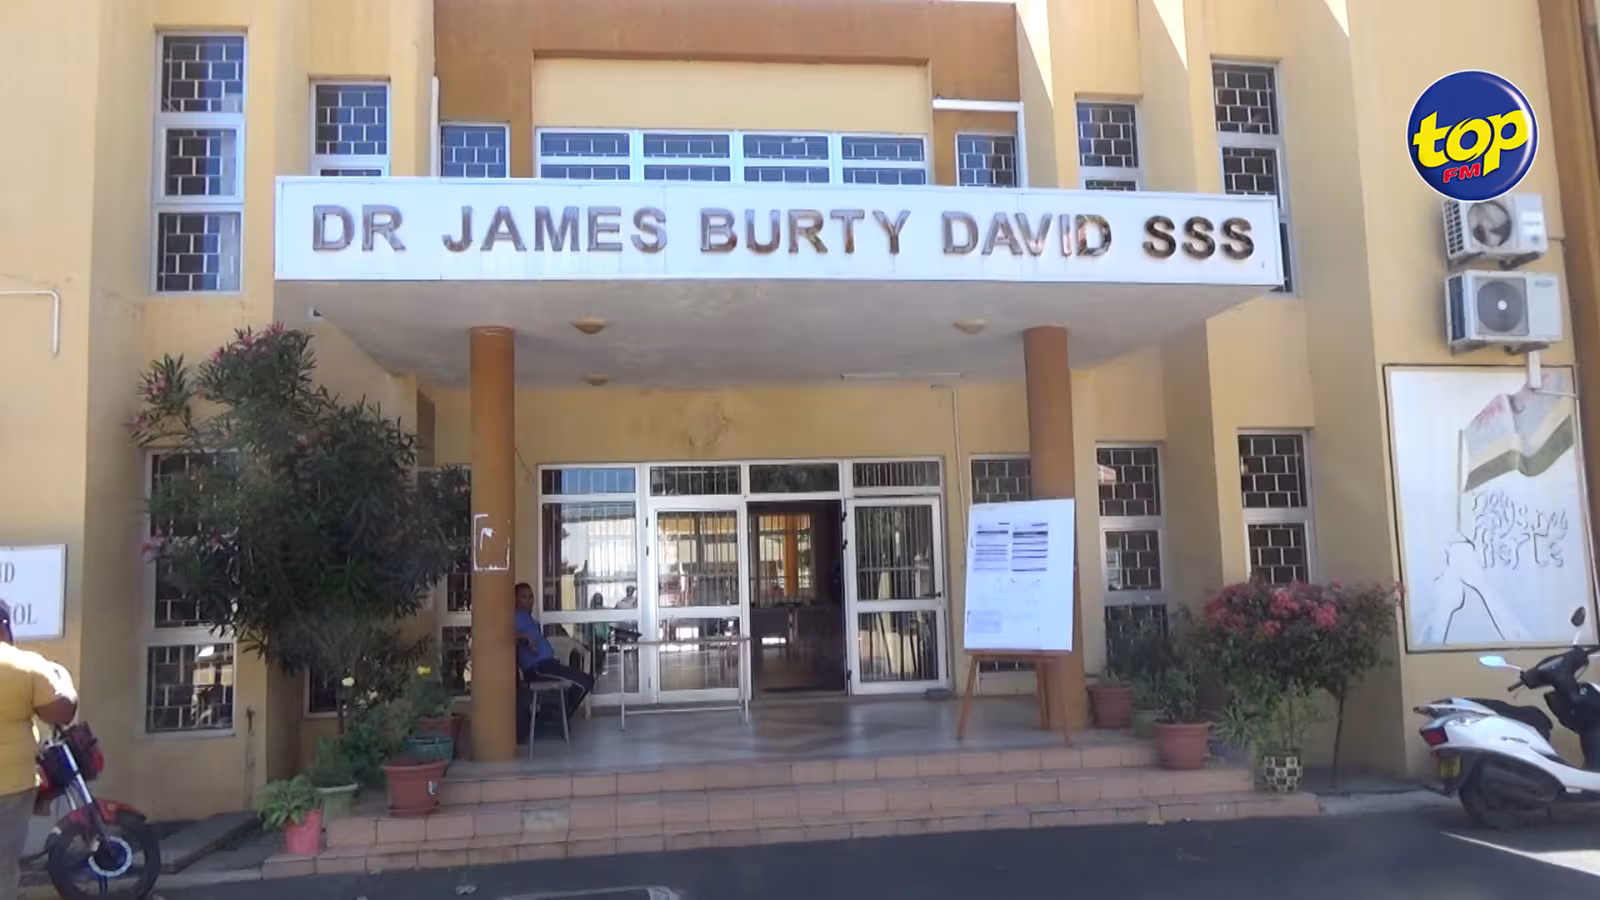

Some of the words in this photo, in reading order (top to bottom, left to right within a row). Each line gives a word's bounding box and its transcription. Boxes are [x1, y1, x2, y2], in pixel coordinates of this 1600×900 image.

[312, 204, 406, 251] DR
[441, 205, 668, 253] JAMES
[700, 207, 912, 255] BURTY
[942, 210, 1112, 258] DAVID
[1142, 215, 1255, 260] SSS
